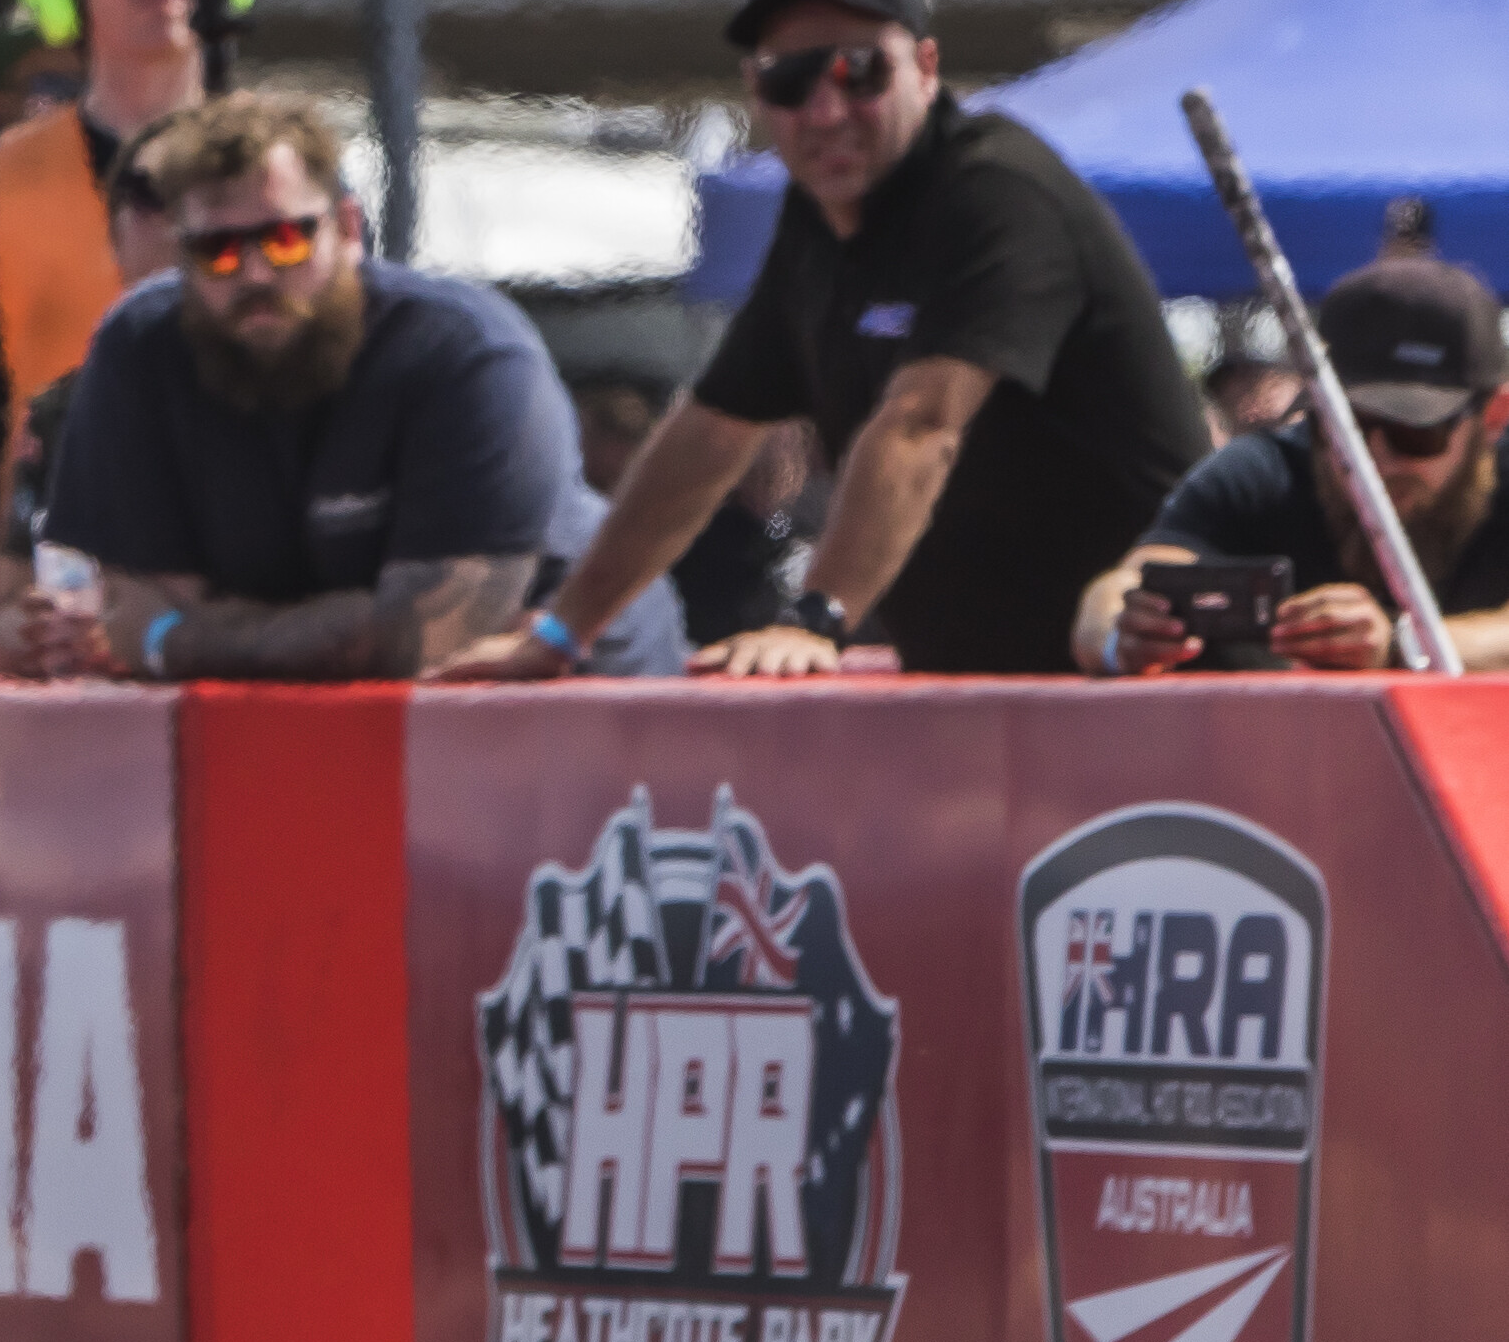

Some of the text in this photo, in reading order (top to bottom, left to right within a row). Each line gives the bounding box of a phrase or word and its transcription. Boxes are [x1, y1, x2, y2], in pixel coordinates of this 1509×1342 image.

[1060, 908, 1289, 1061] IHRA
[559, 992, 815, 1274] HPR
[1095, 1175, 1255, 1239] AUSTRALIA
